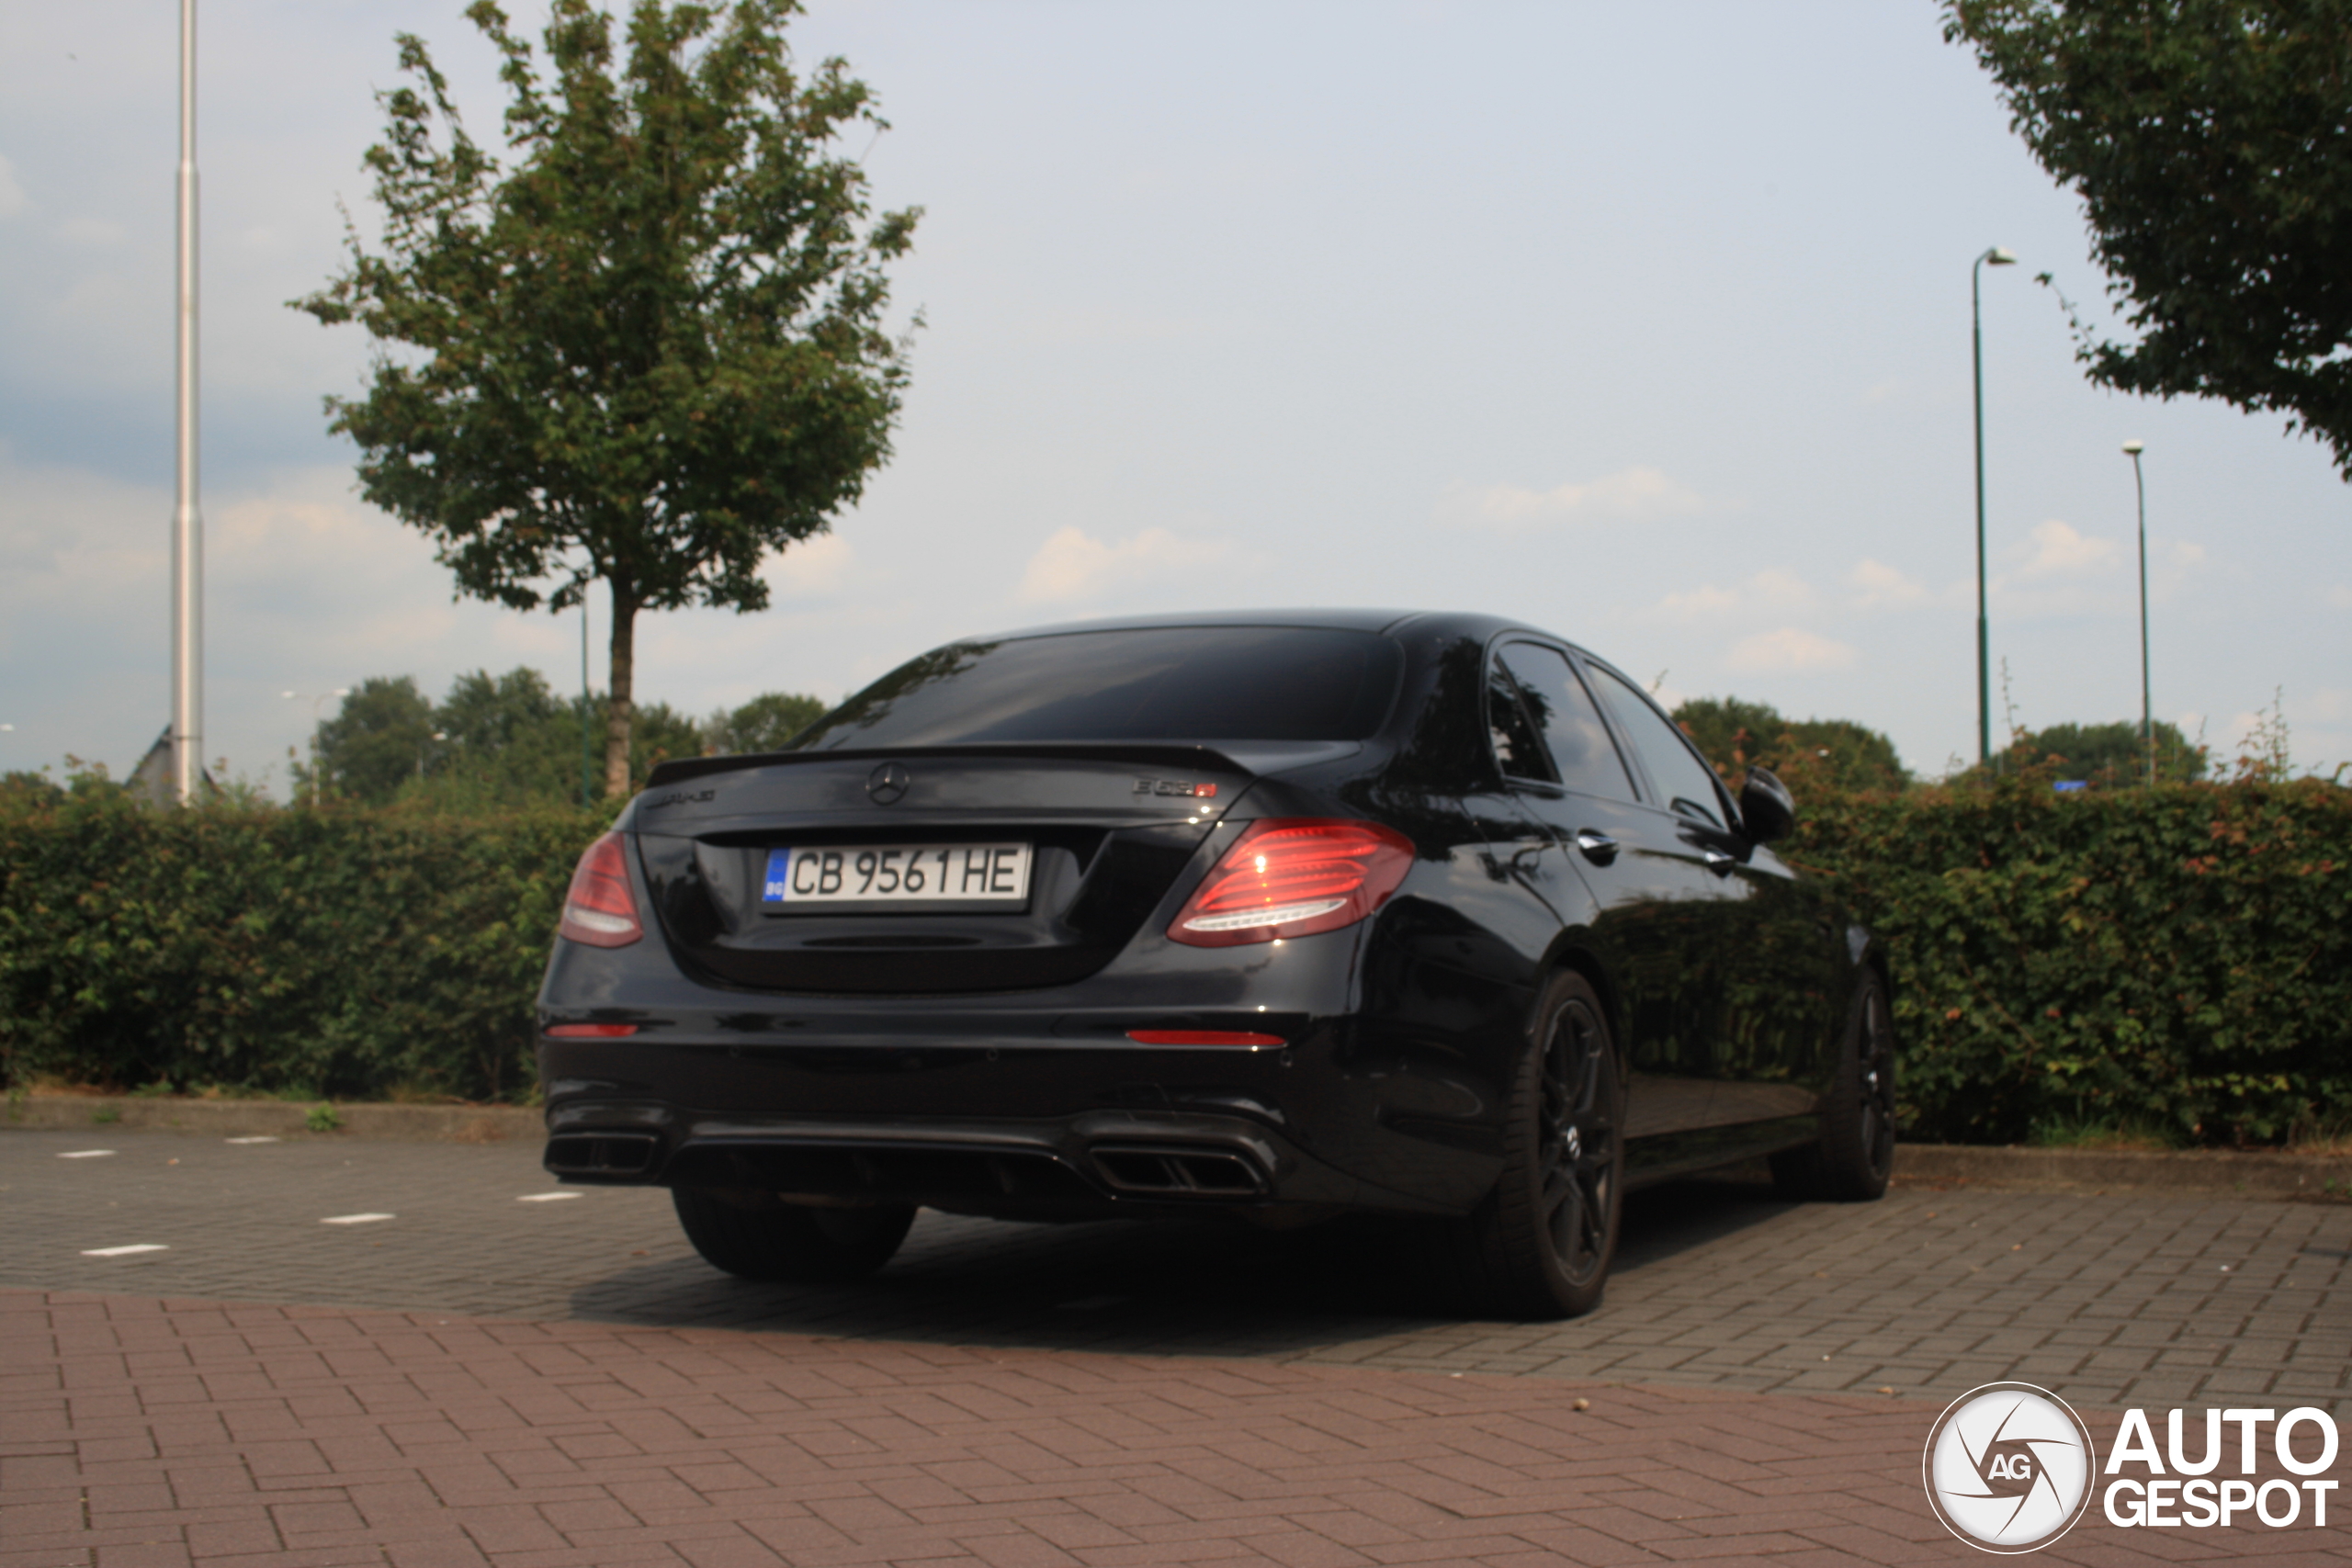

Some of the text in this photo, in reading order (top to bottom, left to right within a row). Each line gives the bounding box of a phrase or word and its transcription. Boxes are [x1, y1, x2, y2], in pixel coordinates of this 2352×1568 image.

[793, 849, 1018, 895] CB 9561 HE
[765, 881, 784, 896] BG
